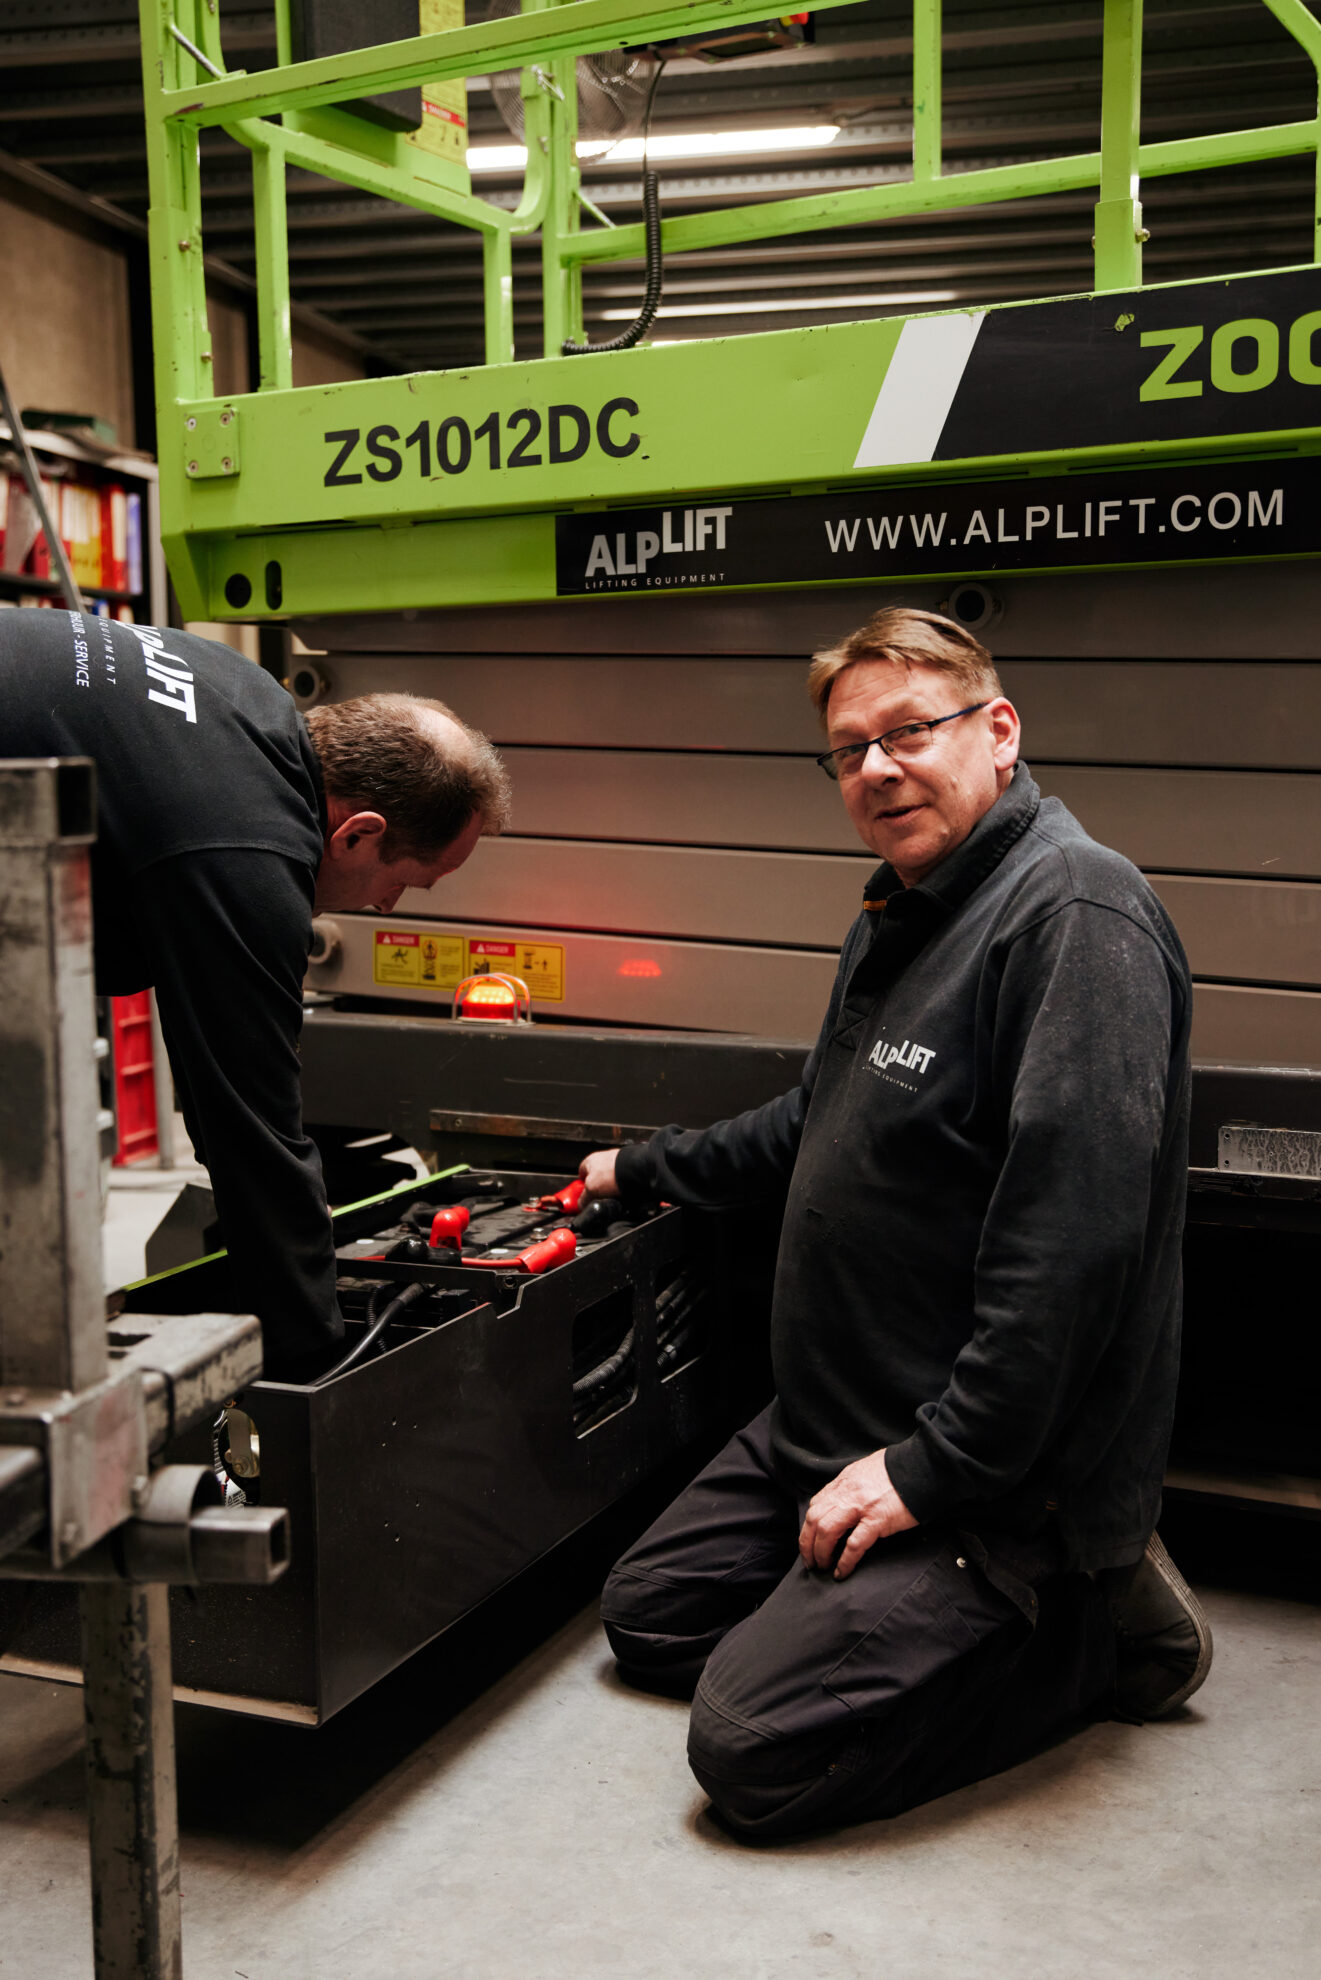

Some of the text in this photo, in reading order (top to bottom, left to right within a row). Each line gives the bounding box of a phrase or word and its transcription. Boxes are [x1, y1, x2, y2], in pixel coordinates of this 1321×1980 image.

[323, 396, 642, 487] ZS1012DC
[584, 506, 733, 578] ALPLIFT
[824, 488, 1285, 554] WWW.ALPLIFT.COM
[585, 573, 726, 590] LIFTING EQUIPMENT
[74, 639, 90, 688] SERVICE
[868, 1040, 936, 1074] ALPLIFT
